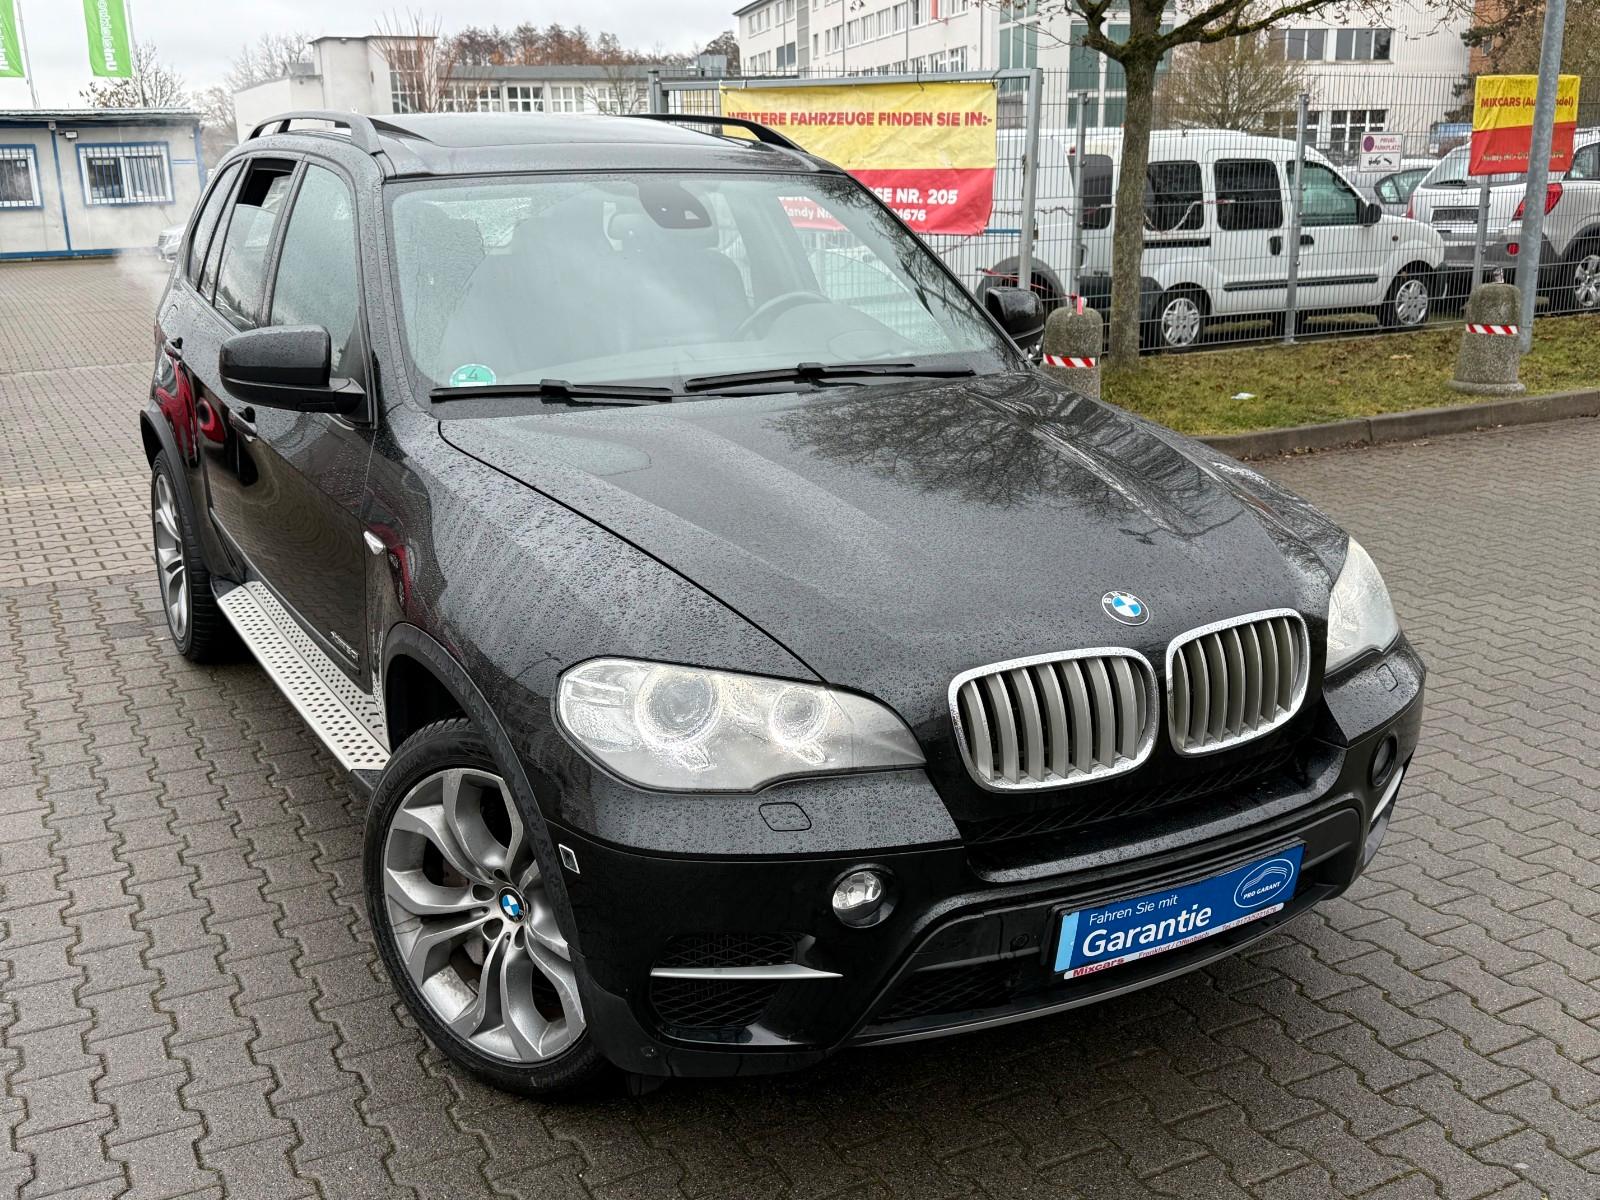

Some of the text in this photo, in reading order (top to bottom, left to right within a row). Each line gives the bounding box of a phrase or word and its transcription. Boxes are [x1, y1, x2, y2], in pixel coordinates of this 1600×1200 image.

[1481, 97, 1521, 108] MIXCARS
[790, 111, 874, 126] FAHRZEUGE
[878, 111, 933, 126] FINDEN
[936, 111, 961, 126] SIE
[895, 187, 923, 204] NR.
[926, 188, 958, 205] 205
[784, 205, 814, 220] andy
[1243, 881, 1281, 900] PRO GARANT
[1089, 894, 1179, 926] Fahren Sie mit
[1082, 903, 1212, 957] Garantie
[1073, 958, 1125, 977] Mixcars
